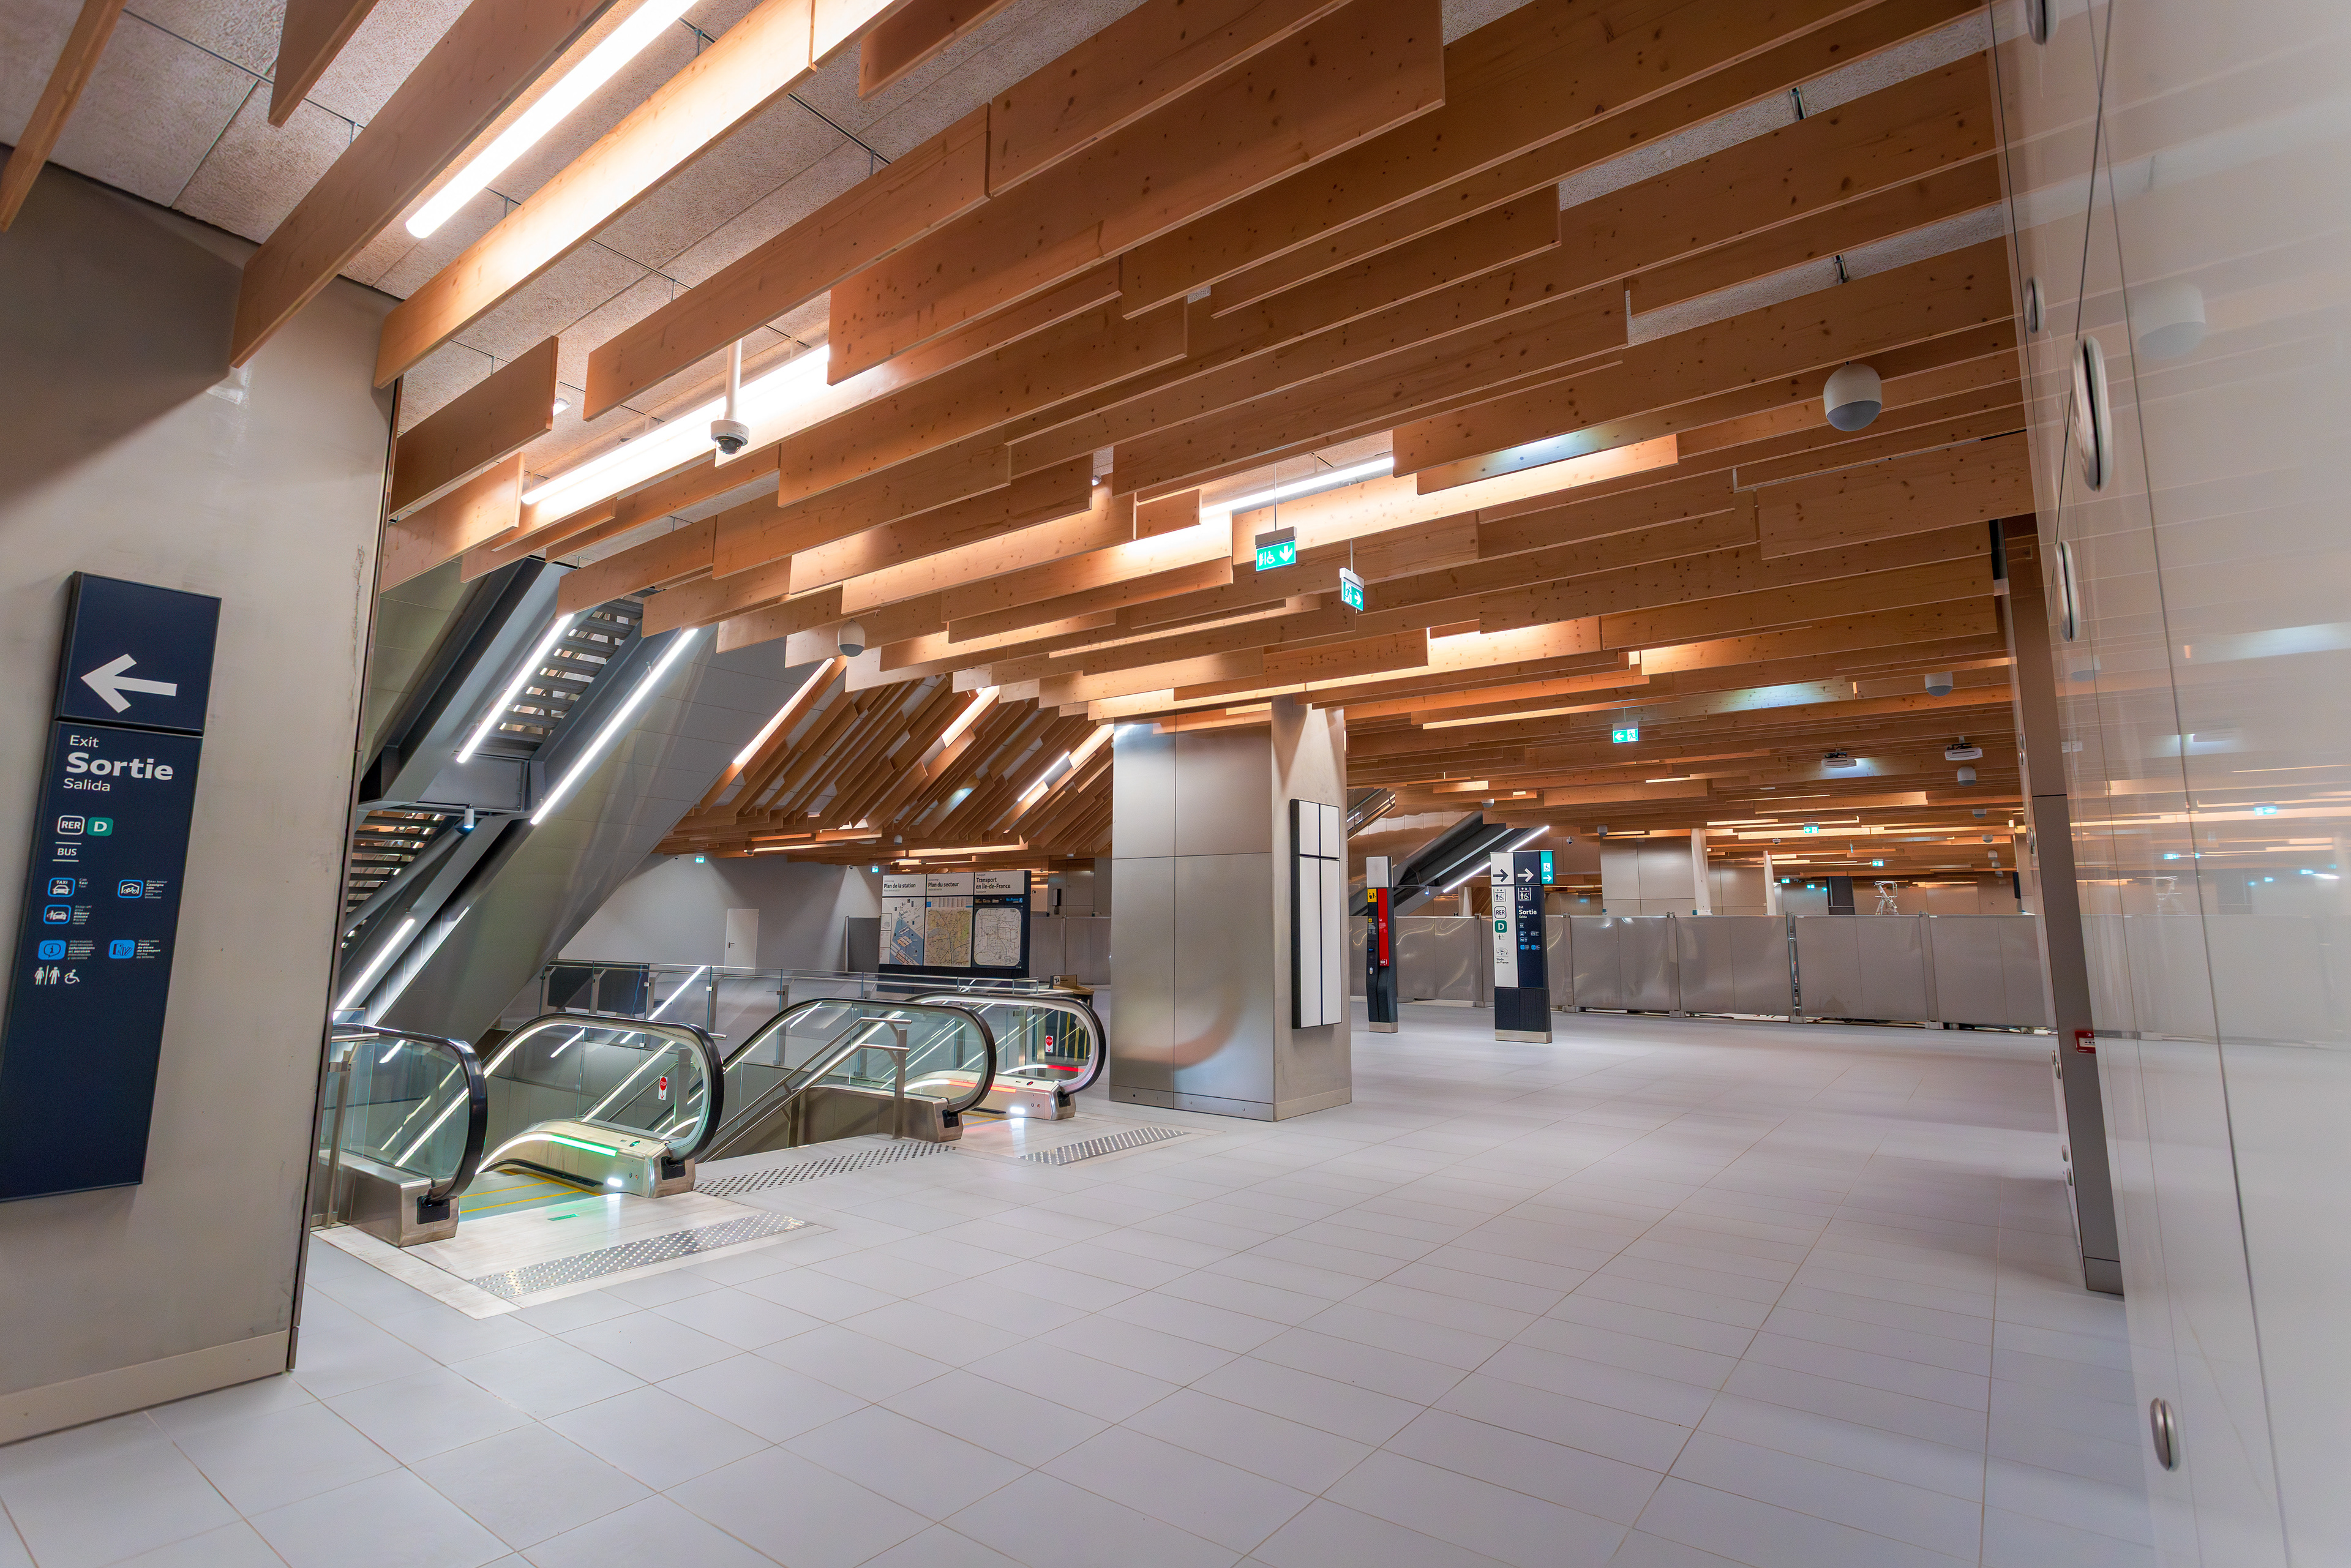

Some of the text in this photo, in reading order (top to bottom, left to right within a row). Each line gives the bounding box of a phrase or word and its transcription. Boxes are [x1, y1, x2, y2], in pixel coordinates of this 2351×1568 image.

[70, 735, 99, 748] Exit
[66, 752, 173, 781] Sortie
[63, 778, 110, 792] Salida
[94, 821, 108, 831] D
